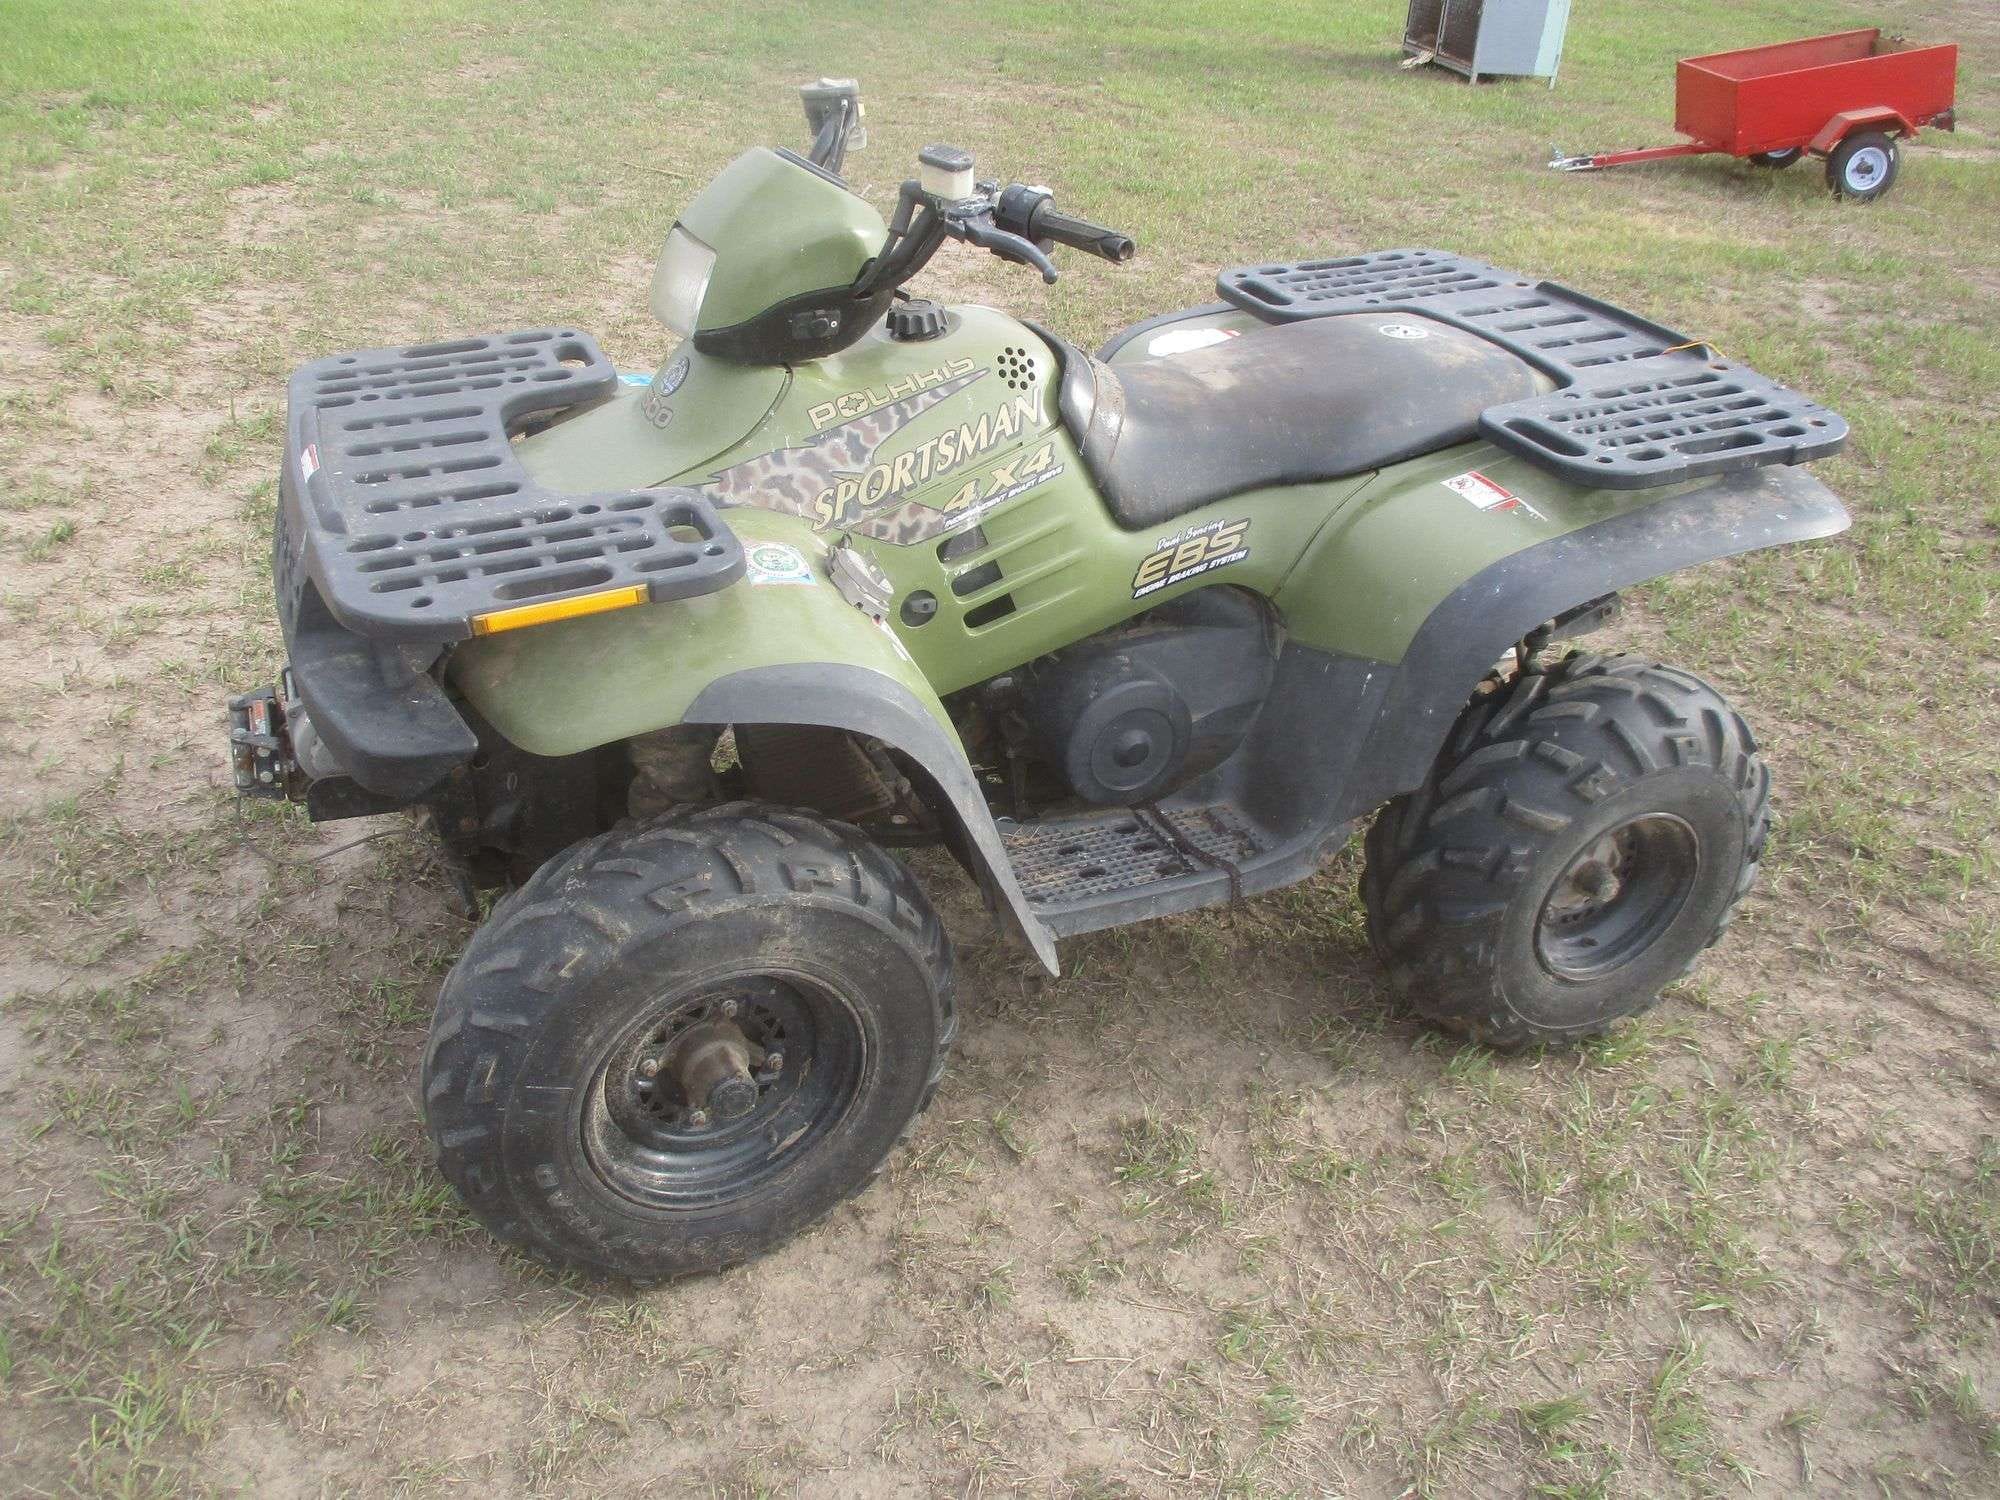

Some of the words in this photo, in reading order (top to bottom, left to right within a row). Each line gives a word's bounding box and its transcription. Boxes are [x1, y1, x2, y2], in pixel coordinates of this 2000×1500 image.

[807, 357, 976, 430] POLARIS
[812, 387, 1047, 532] SPORTSMAN
[1133, 519, 1249, 588] EBS
[1208, 549, 1248, 570] SYSTEM
